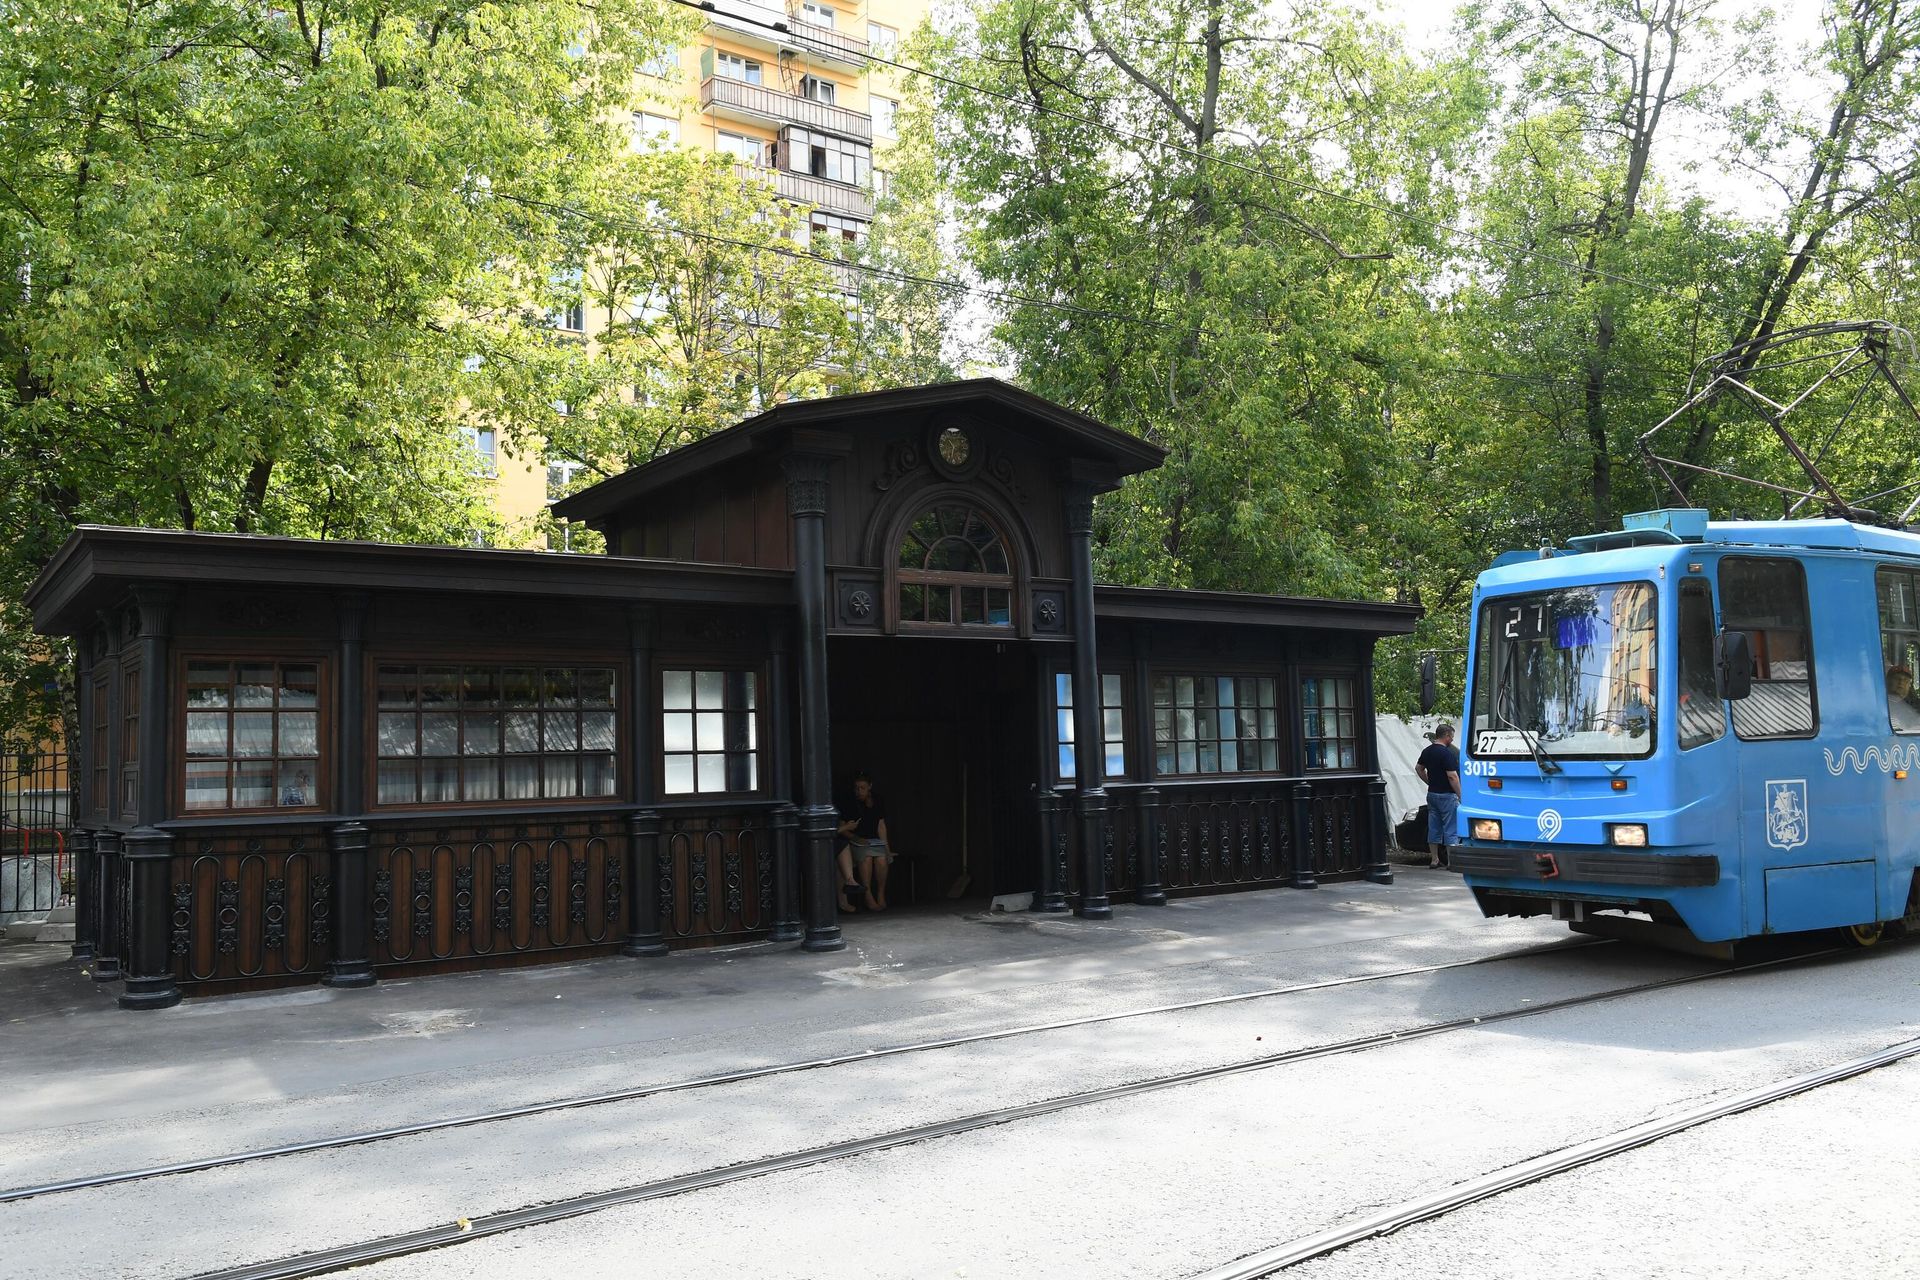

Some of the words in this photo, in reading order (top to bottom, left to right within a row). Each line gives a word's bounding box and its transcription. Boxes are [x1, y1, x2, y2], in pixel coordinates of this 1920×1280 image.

[1505, 604, 1543, 638] 27
[1480, 736, 1497, 753] 27
[1464, 761, 1497, 776] 3015
